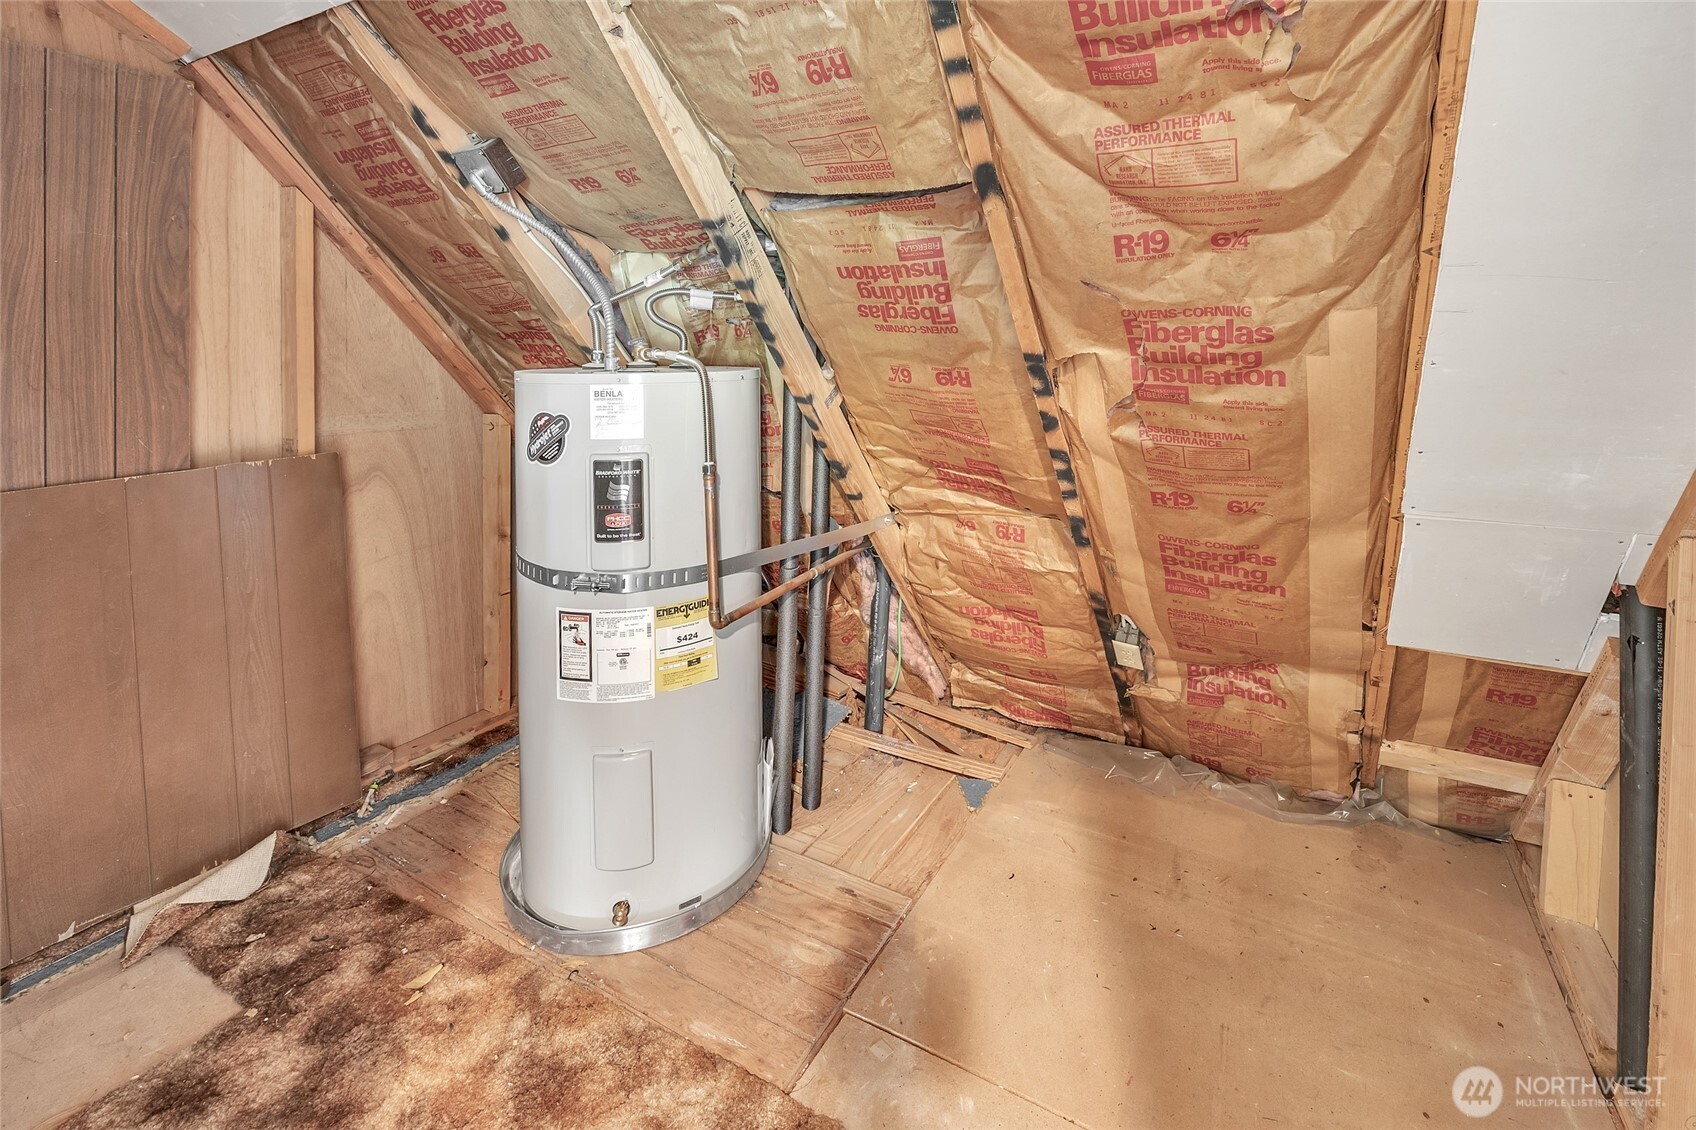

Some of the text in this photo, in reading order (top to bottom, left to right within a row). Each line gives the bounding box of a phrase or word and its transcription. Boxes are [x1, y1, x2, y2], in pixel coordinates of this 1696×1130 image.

[415, 0, 507, 34] Fiberglas
[437, 21, 523, 56] Building
[1075, 7, 1273, 58] Insulation
[459, 42, 552, 78] Insulation
[797, 52, 814, 62] ONLY
[1202, 58, 1226, 66] Apply
[1092, 68, 1152, 81] FIBERGLAS
[1203, 64, 1253, 74] toward living
[502, 99, 567, 120] ASSURED THERMAL
[506, 109, 559, 127] PERFORMANCE
[1094, 110, 1236, 140] ASSURED THERMAL
[334, 138, 404, 166] Insulation
[1095, 129, 1201, 152] PERFORMANCE
[356, 158, 418, 182] Building
[811, 171, 895, 184] ASSURED THERMAL
[825, 161, 892, 174] PERFORMANCE
[365, 176, 432, 199] Fiberglas
[845, 203, 936, 217] ASSURED THERMAL
[899, 242, 940, 253] FIBERGLAS
[1116, 254, 1156, 263] INSULATION
[836, 260, 948, 283] Insulation
[856, 281, 952, 305] Building
[857, 302, 956, 325] Fiberglas
[1121, 306, 1252, 318] OWENS-CORNING
[874, 324, 959, 334] OWENS-CORNING
[1123, 319, 1274, 349] Fiberglas
[1127, 336, 1263, 368] Building
[1130, 358, 1286, 387] Insulation
[1138, 421, 1248, 441] ASSURED THERMAL
[1139, 430, 1222, 448] PERFORMANCE
[1158, 534, 1260, 550] OWENS-CORNING
[1158, 540, 1277, 567] Fiberglas
[1160, 554, 1267, 582] Building
[1163, 566, 1286, 598] Insulation
[656, 599, 709, 617] ENERGYGUID
[1167, 608, 1209, 618] ASSURED
[677, 632, 698, 643] $424
[970, 628, 1046, 654] Fiberglas
[1187, 677, 1287, 709] Insulation
